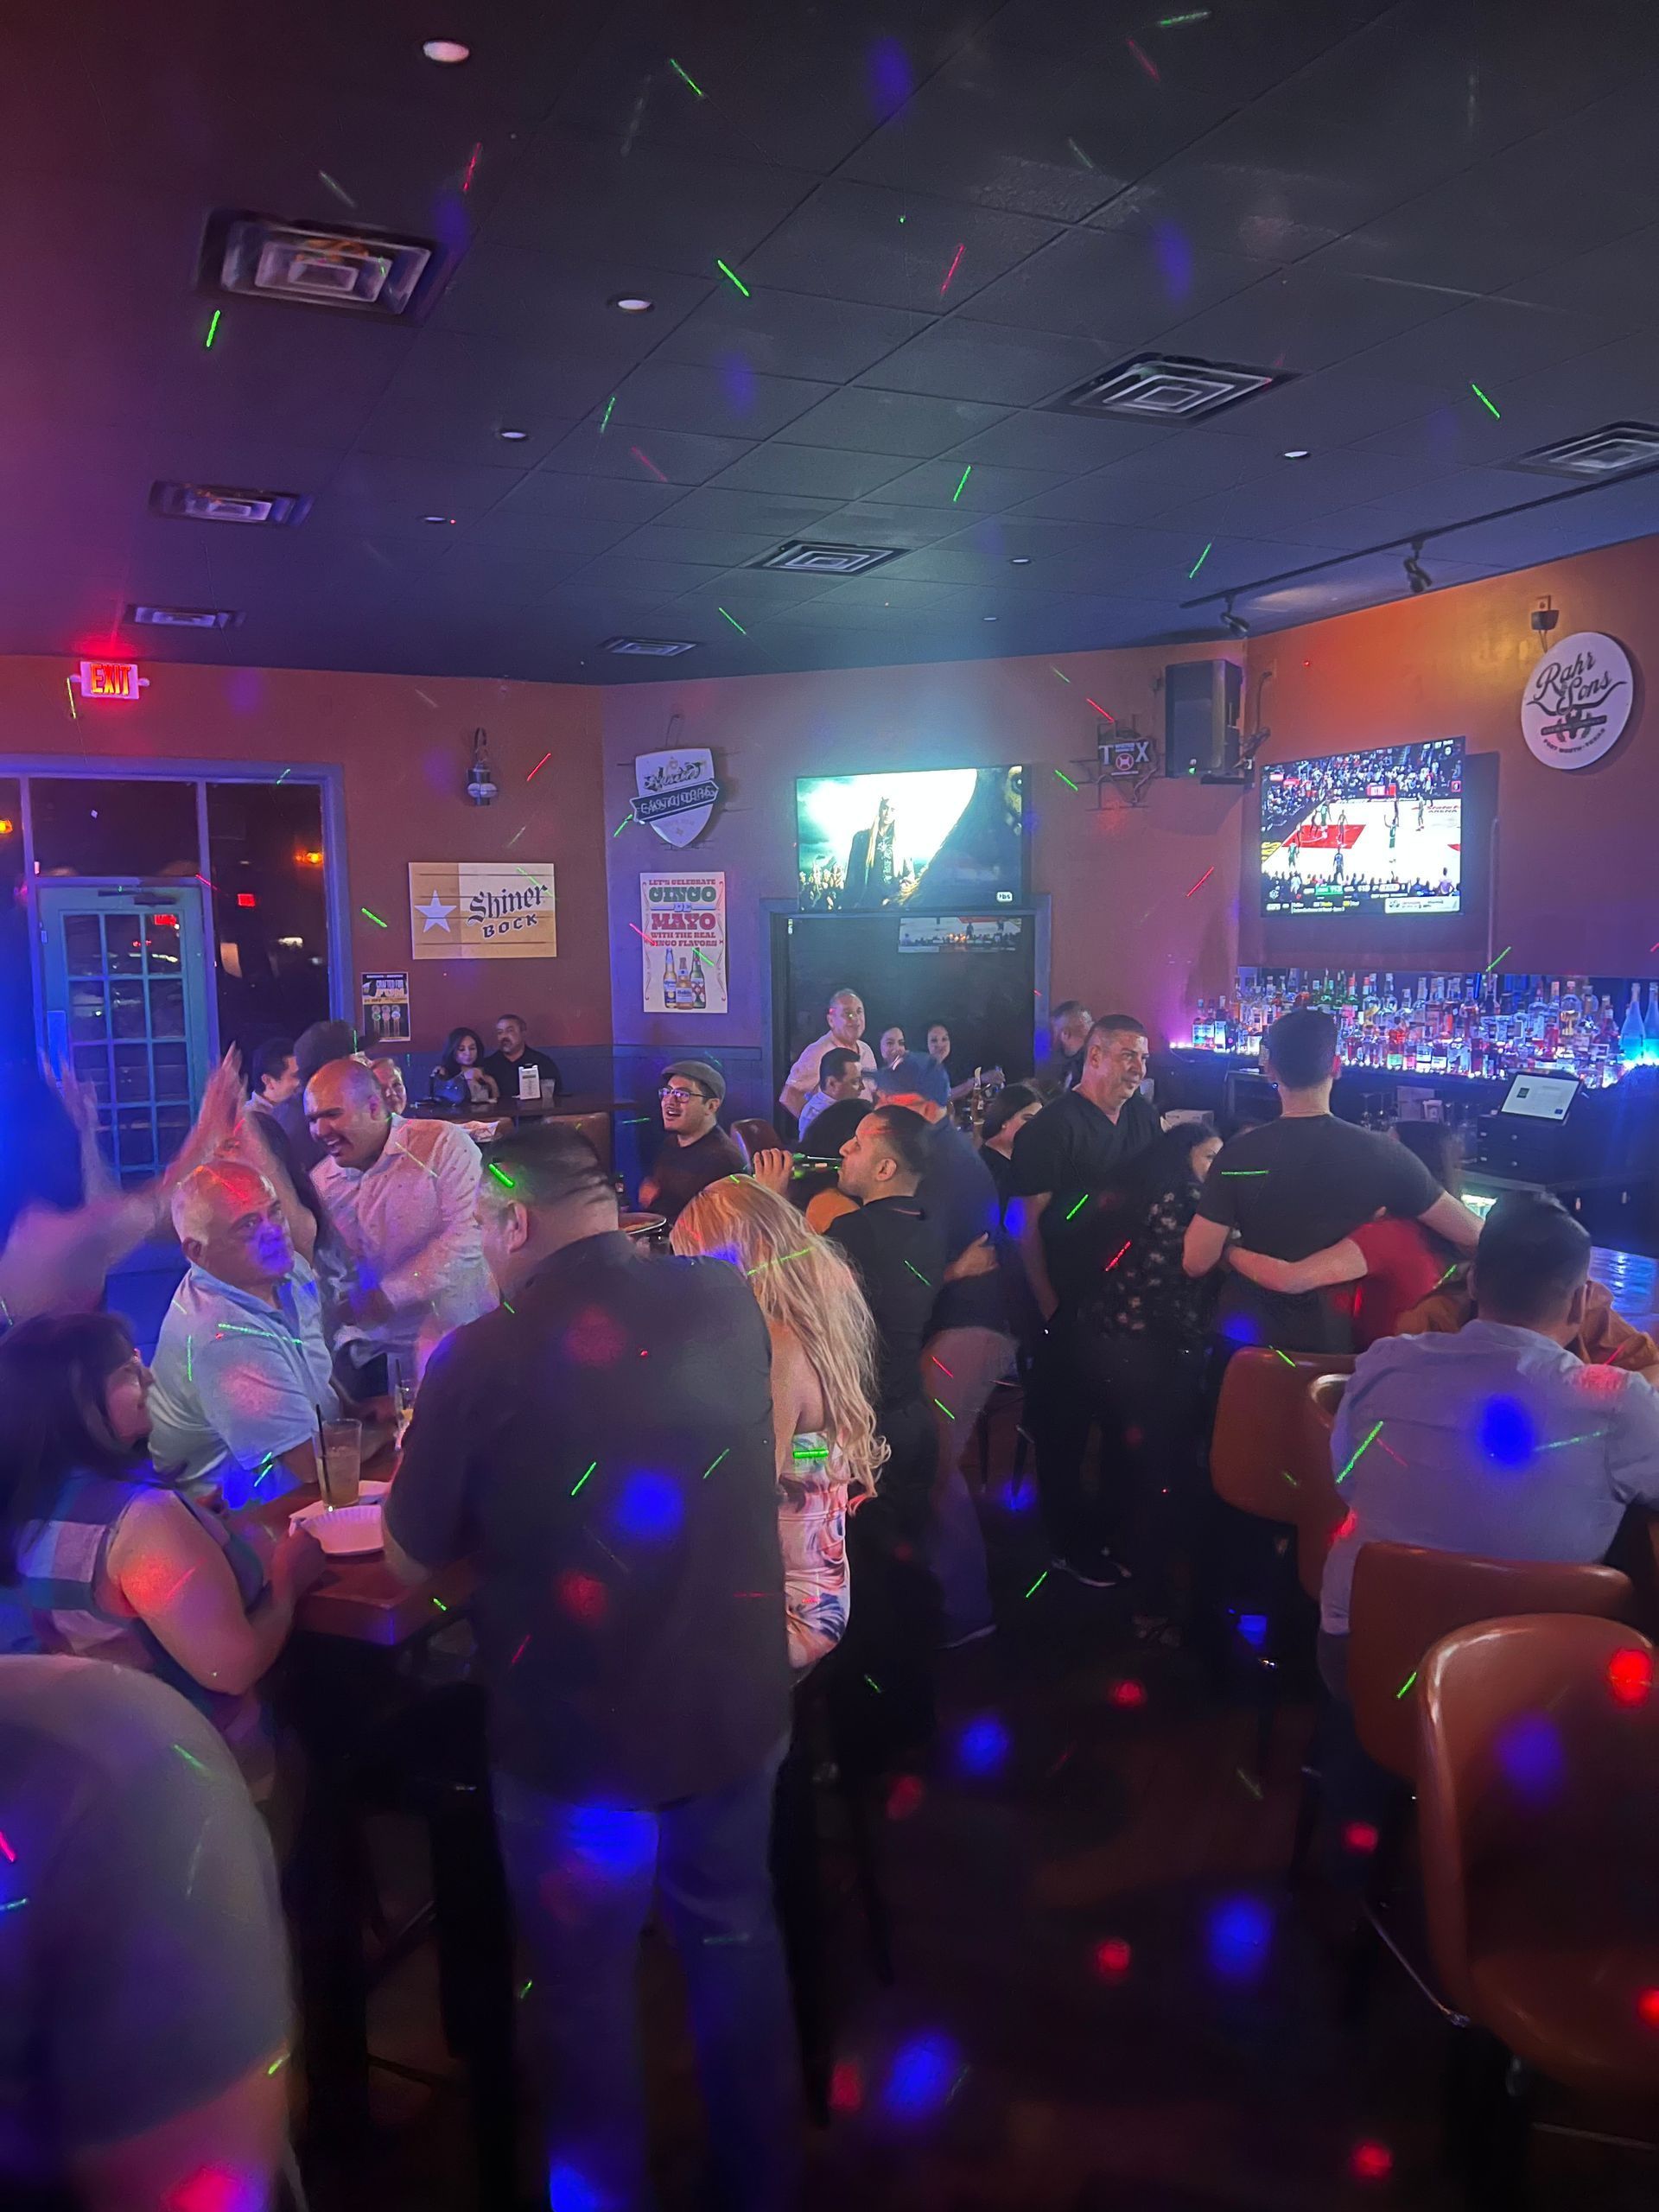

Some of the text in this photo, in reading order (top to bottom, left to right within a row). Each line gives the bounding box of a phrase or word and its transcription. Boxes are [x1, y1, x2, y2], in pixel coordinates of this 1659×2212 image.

[91, 664, 131, 696] EXIT
[1534, 652, 1596, 701] Rahr
[1556, 671, 1611, 715] Sons
[467, 884, 548, 926] Shiner
[649, 886, 716, 903] CINCO
[674, 902, 692, 912] DE
[482, 913, 537, 939] BOCK
[652, 912, 716, 931] MAYO
